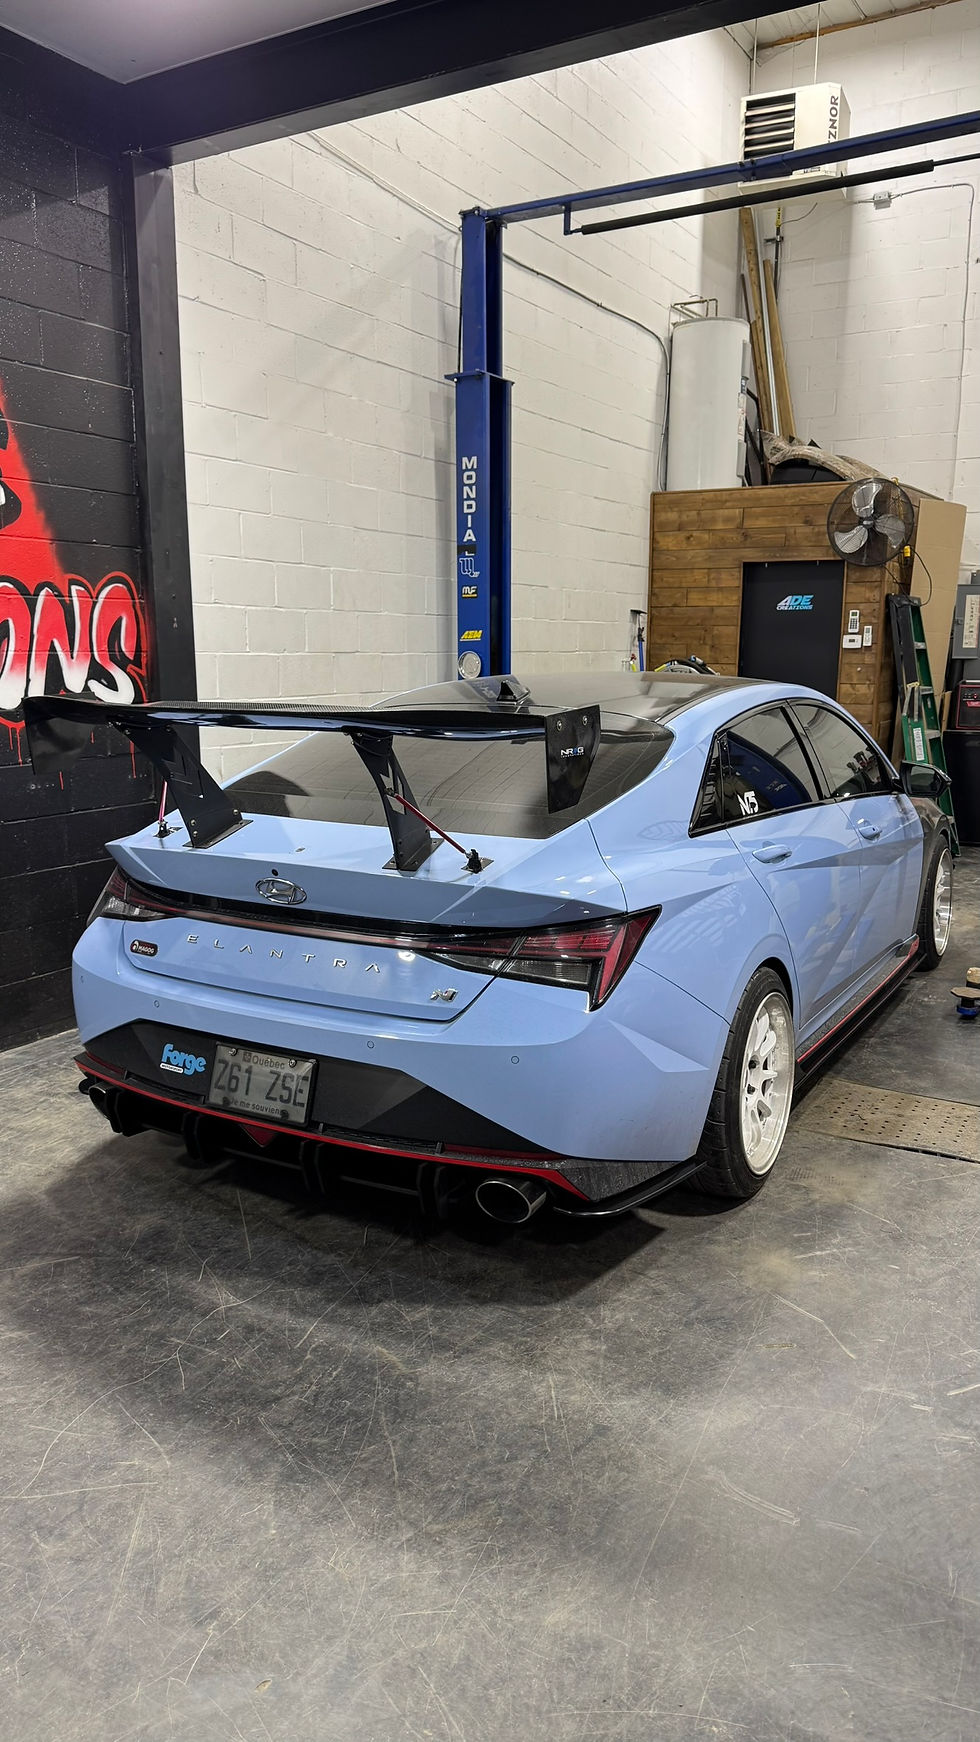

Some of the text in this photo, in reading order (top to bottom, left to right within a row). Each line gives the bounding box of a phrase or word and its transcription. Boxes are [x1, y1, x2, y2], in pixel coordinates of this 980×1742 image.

[827, 95, 839, 143] ZNOR
[777, 594, 814, 606] ADE
[187, 934, 382, 973] ELANTRA
[162, 1044, 206, 1075] forge
[252, 1055, 286, 1070] Québec
[214, 1059, 309, 1107] Z61 ZSE
[240, 1100, 251, 1109] me
[251, 1103, 281, 1115] souvien
